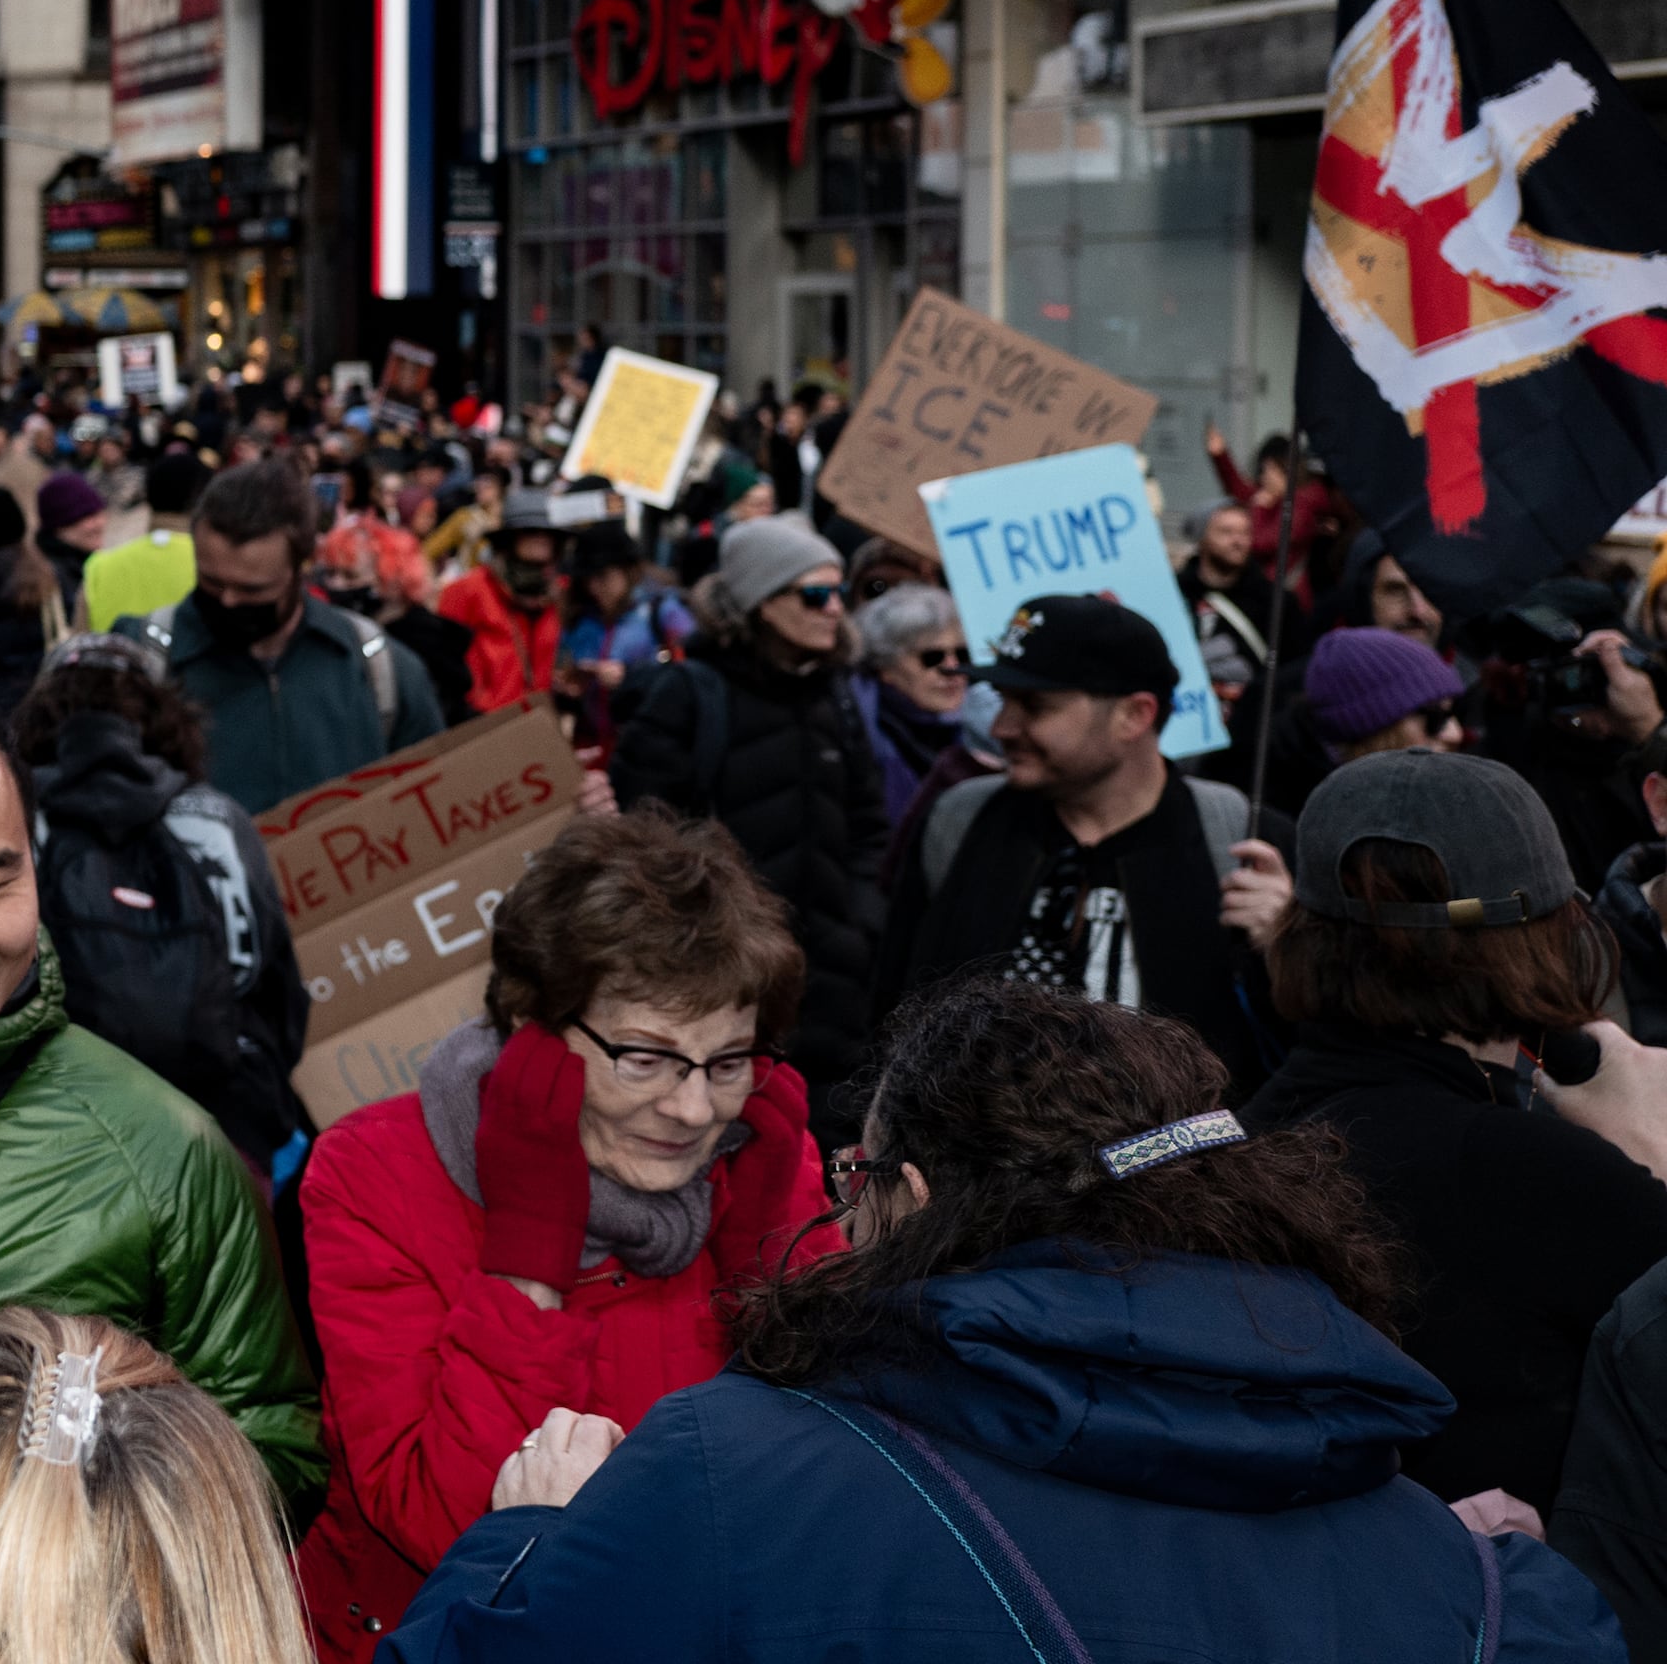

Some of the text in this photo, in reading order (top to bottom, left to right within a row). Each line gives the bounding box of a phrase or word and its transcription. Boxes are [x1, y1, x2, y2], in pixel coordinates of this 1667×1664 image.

[944, 493, 1140, 591] TRUMP
[390, 762, 555, 849] TAXES
[339, 934, 412, 988] the
